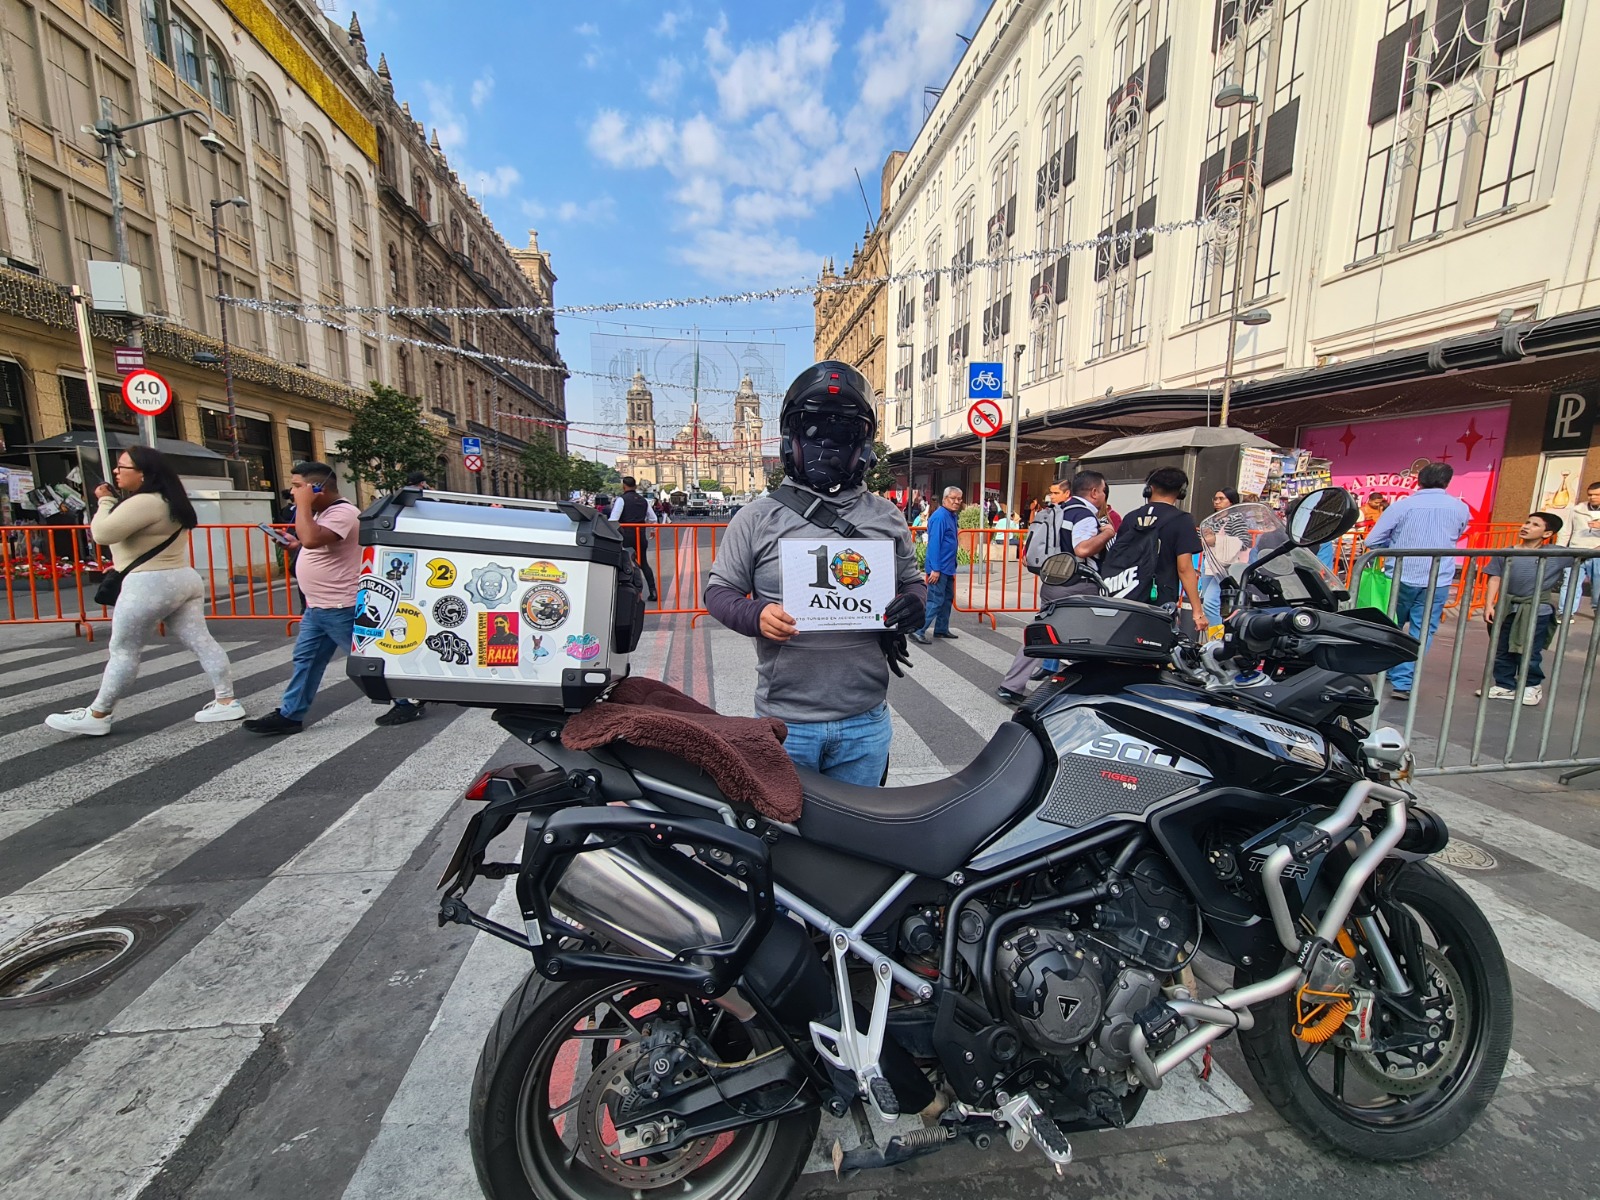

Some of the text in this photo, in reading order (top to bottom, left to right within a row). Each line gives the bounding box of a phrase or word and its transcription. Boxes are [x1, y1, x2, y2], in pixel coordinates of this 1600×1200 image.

[134, 380, 160, 395] 40
[136, 397, 160, 405] km/h
[1365, 474, 1420, 491] RECET
[436, 564, 450, 581] 2
[1100, 566, 1139, 597] NIKE
[808, 590, 872, 613] AÑOS
[395, 608, 420, 618] ANOK
[488, 648, 518, 660] RALLY
[1260, 722, 1319, 745] TRIUMPH
[1089, 738, 1179, 772] 900
[1100, 770, 1138, 785] TIGER
[1122, 782, 1137, 791] 900
[1248, 857, 1309, 880] TER
[1298, 940, 1313, 964] KOVIX
